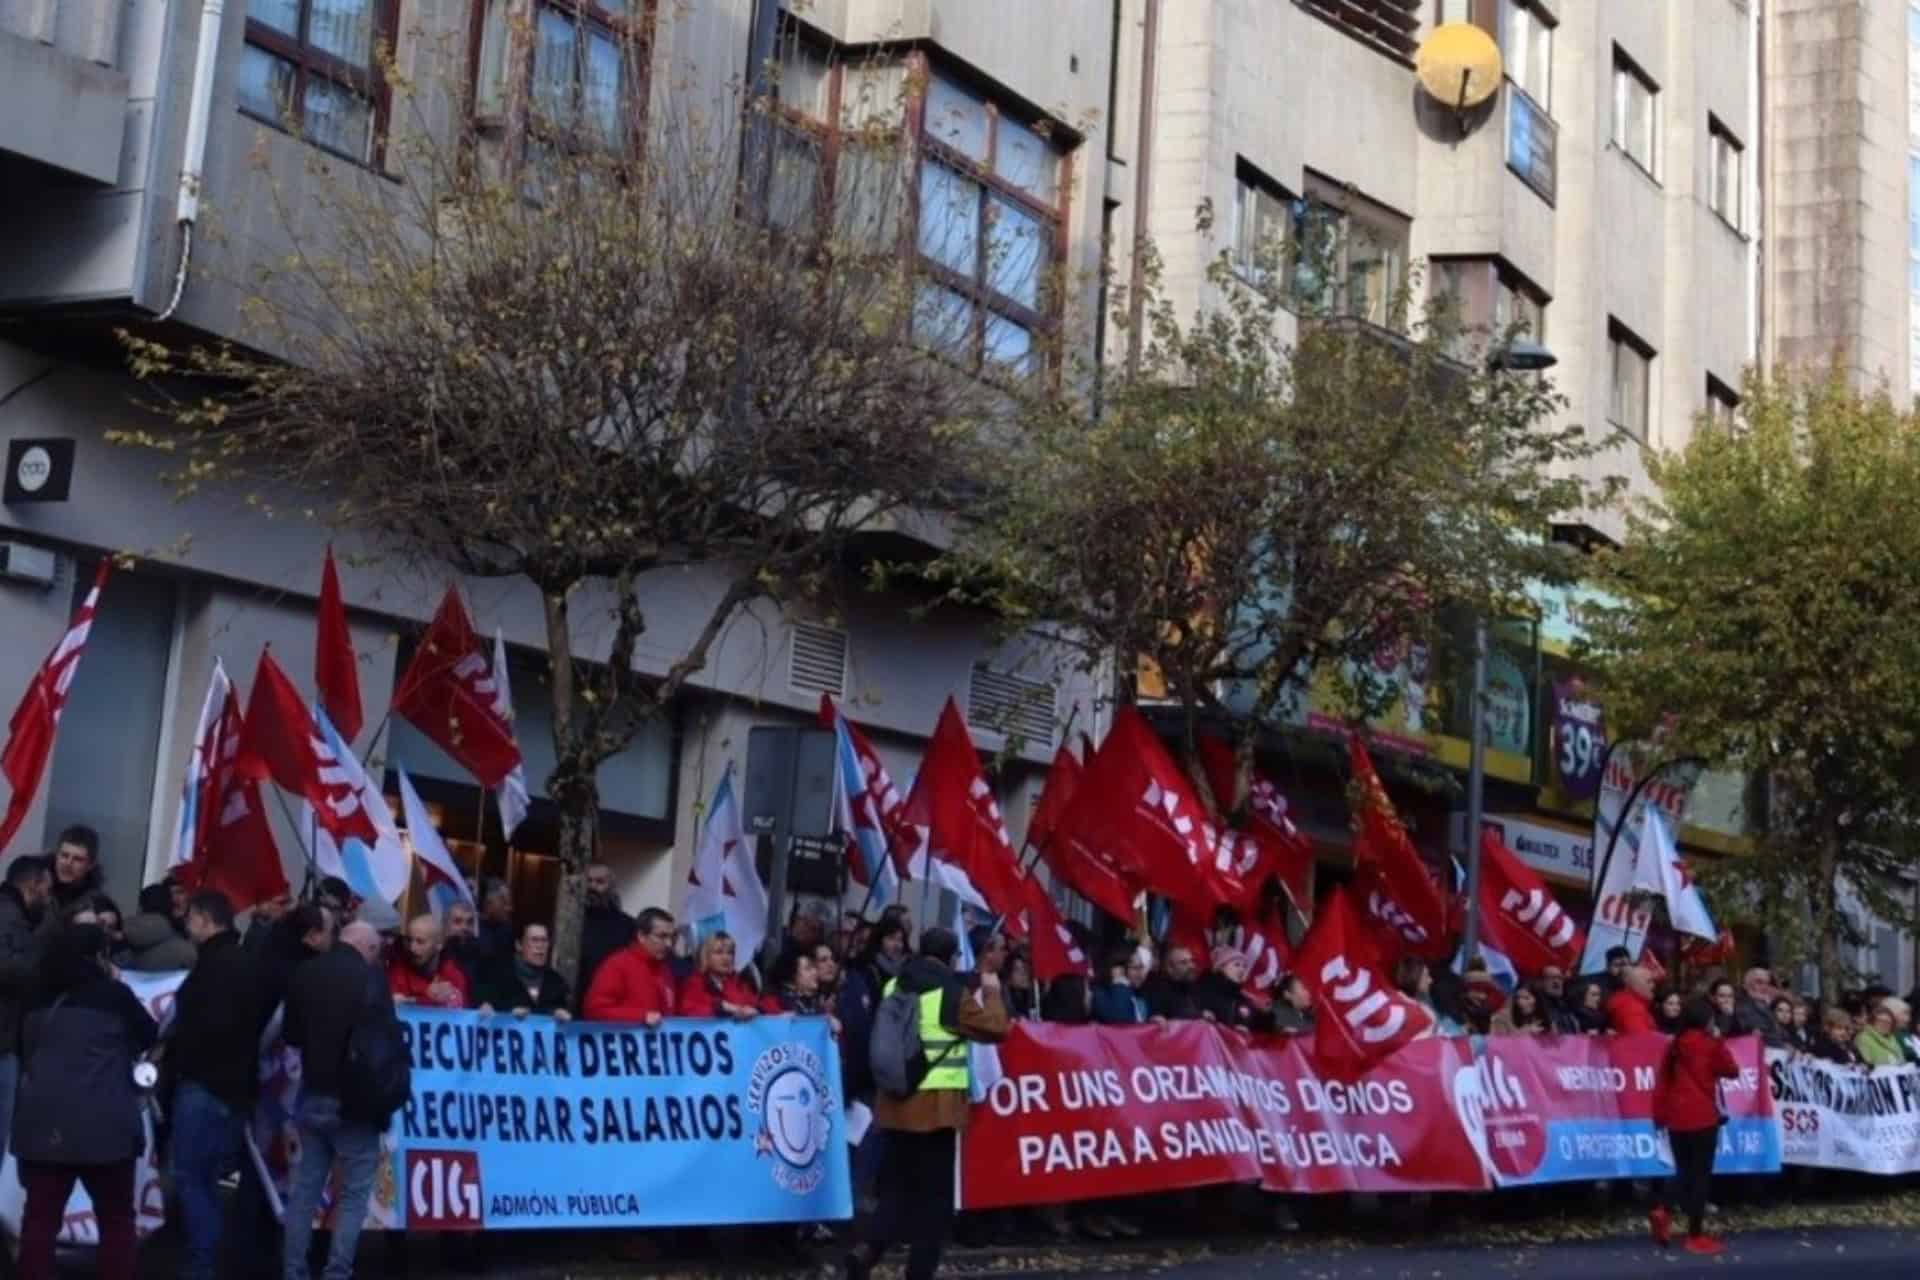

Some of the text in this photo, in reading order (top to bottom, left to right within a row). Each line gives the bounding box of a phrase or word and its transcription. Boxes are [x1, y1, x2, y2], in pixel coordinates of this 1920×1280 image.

[402, 1022, 734, 1077] RECUPERAR DEREITOS
[1058, 1068, 1126, 1112] UNS
[1296, 1078, 1413, 1116] DIGNOS
[403, 1092, 744, 1143] RECUPERAR SALARIOS
[1018, 1127, 1127, 1175] PARA
[1133, 1125, 1158, 1164] A
[410, 1158, 479, 1219] CIG
[567, 1188, 641, 1217] PÚBLICA
